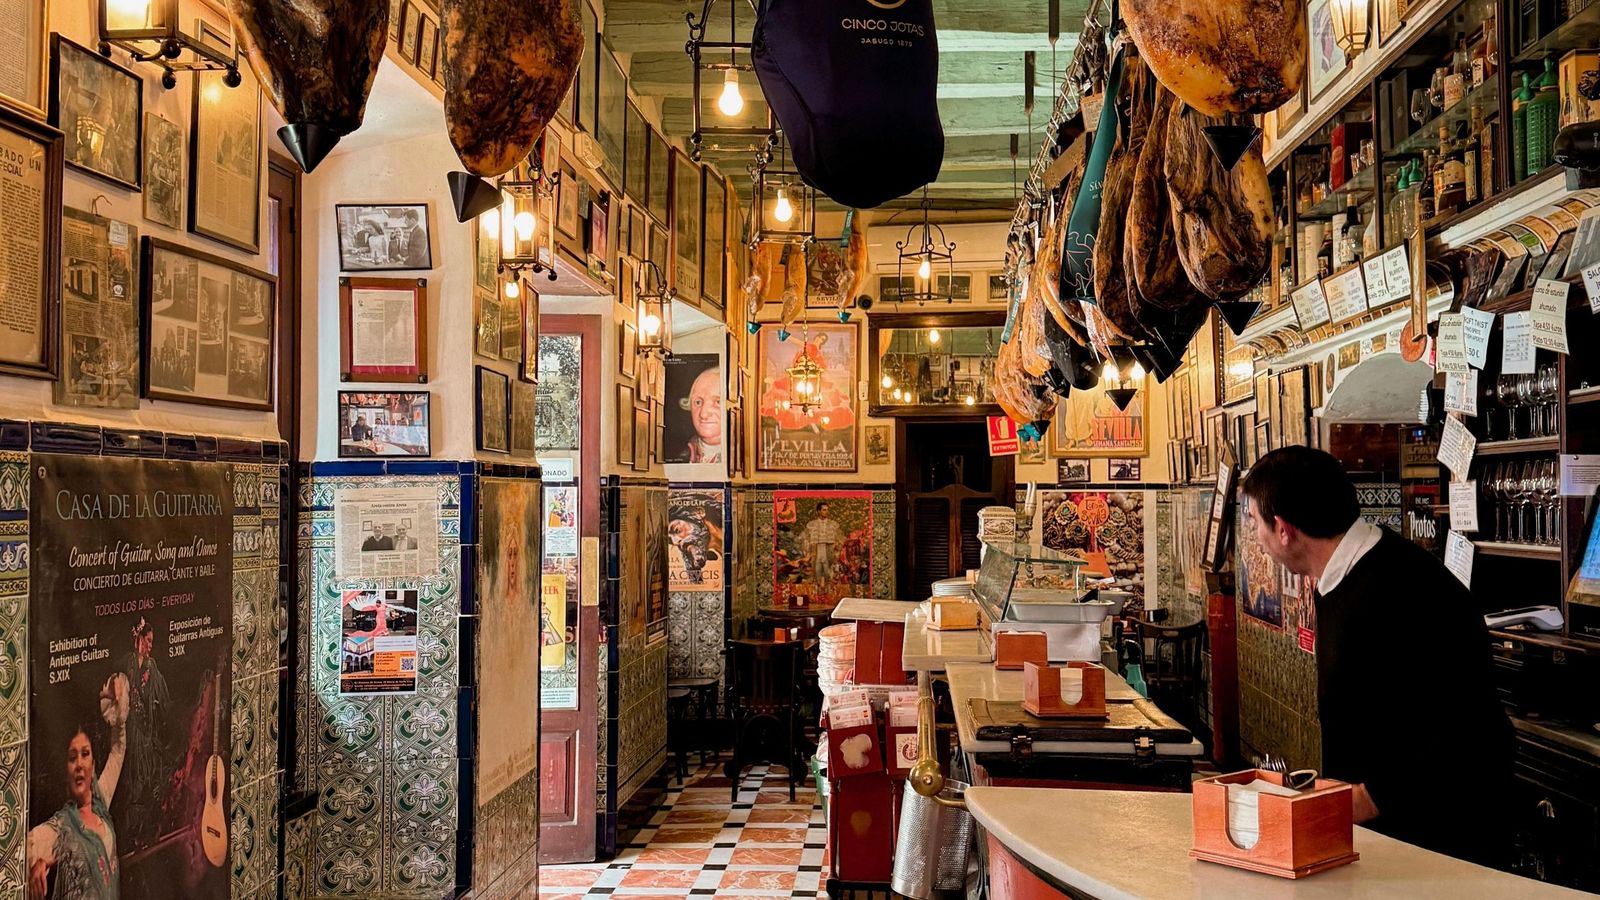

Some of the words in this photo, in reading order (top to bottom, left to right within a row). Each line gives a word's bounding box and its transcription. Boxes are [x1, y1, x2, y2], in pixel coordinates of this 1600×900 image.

[841, 18, 887, 30] CINCO
[889, 20, 925, 37] JOTAS
[861, 37, 894, 46] JABUGO
[29, 157, 42, 172] UN
[1091, 417, 1142, 440] SEVILLA
[767, 438, 847, 453] SEVILLA
[56, 489, 103, 521] CASA
[108, 494, 130, 519] DE
[135, 494, 151, 518] LA
[153, 490, 223, 518] GUITARRA
[1407, 510, 1436, 541] Protos
[69, 545, 107, 569] Concert
[108, 540, 121, 571] of
[121, 542, 153, 566] Guitar,
[154, 540, 177, 570] Song
[178, 535, 197, 559] and
[196, 537, 218, 558] Dance
[74, 576, 121, 592] CONCIERTO
[122, 572, 132, 586] DE
[134, 567, 171, 584] GUITARRA,
[172, 567, 194, 581] CANTE
[194, 566, 200, 578] Y
[199, 563, 216, 577] BAILE
[95, 601, 121, 617] TODOS
[121, 599, 137, 614] LOS
[161, 592, 196, 609] EVERYDAY
[169, 617, 202, 632] Exposición
[203, 615, 212, 626] de
[49, 637, 88, 654] Exhibition
[88, 633, 98, 647] of
[168, 629, 198, 645] Guitarras
[198, 625, 224, 639] Antiguas
[49, 653, 80, 669] Antique
[81, 647, 110, 662] Guitars
[168, 645, 186, 658] S.XIX
[49, 668, 71, 684] S.XIX
